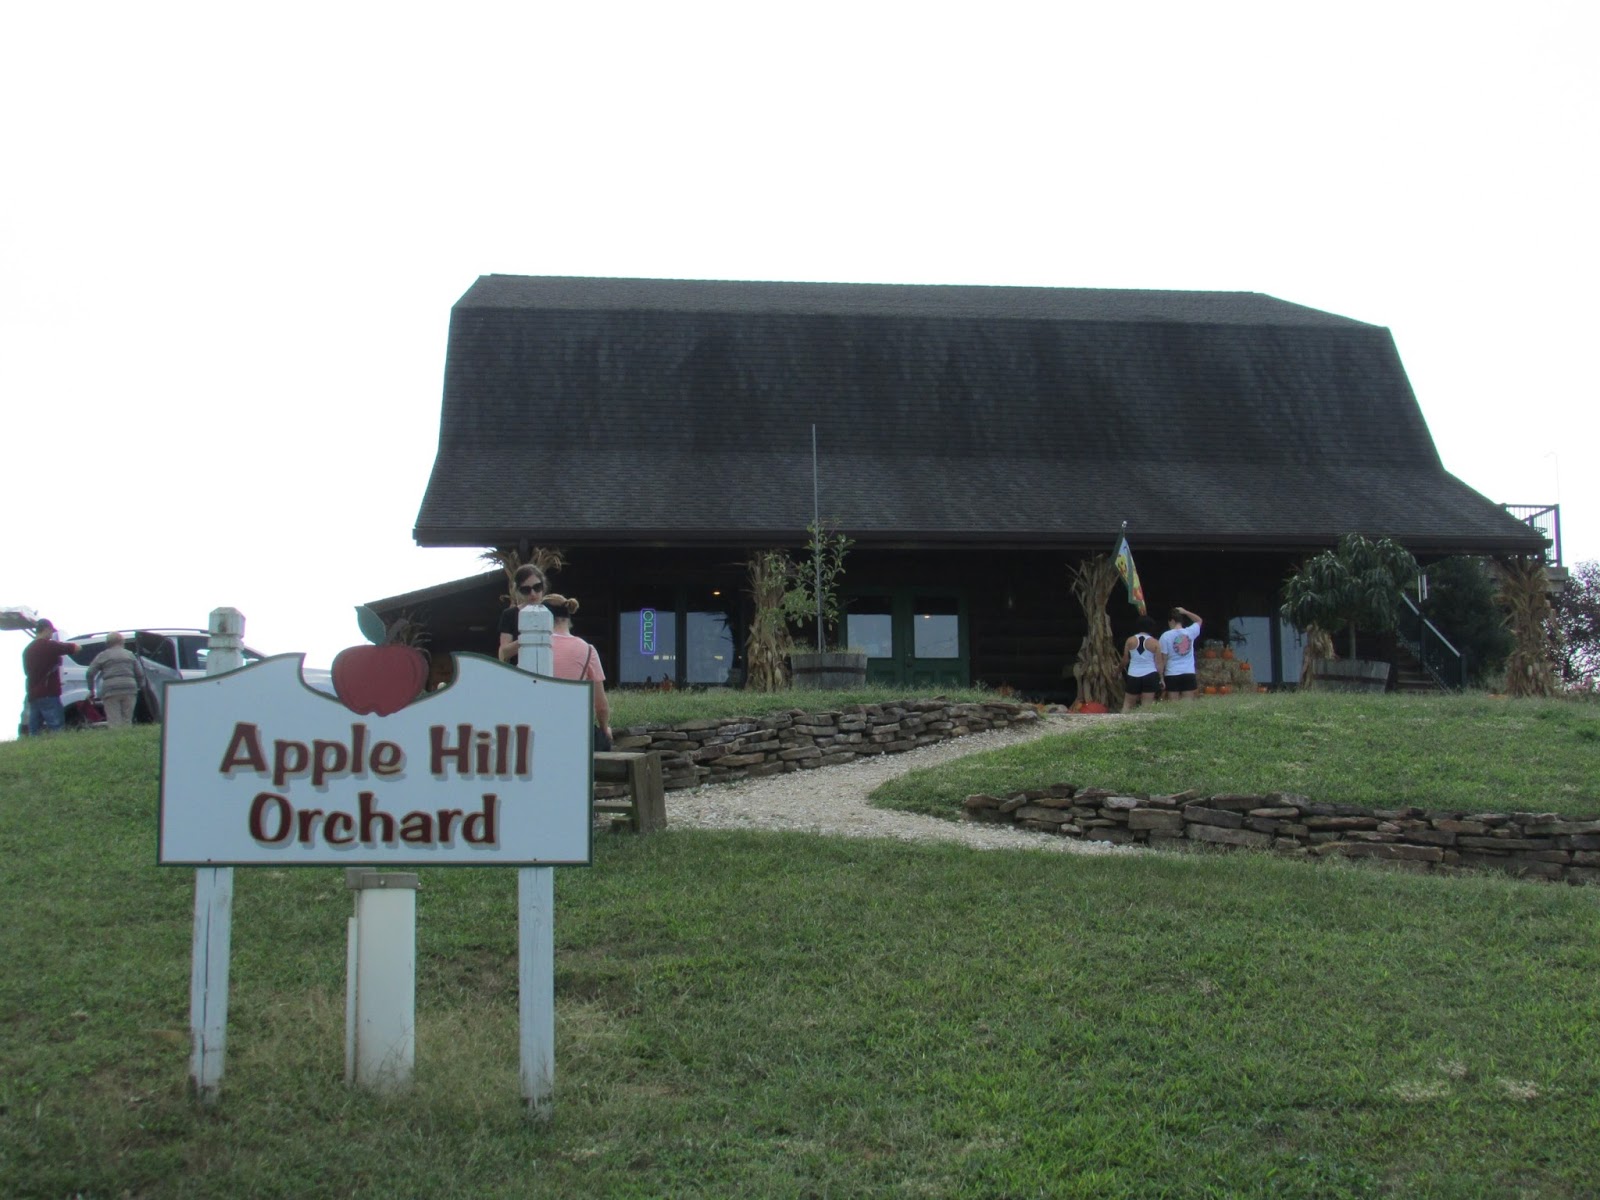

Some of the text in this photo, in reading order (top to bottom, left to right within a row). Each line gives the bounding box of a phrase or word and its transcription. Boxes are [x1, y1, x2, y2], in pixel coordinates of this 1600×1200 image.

[643, 611, 654, 652] OPEN
[219, 721, 532, 787] Apple Hill
[248, 791, 498, 845] Orchard
